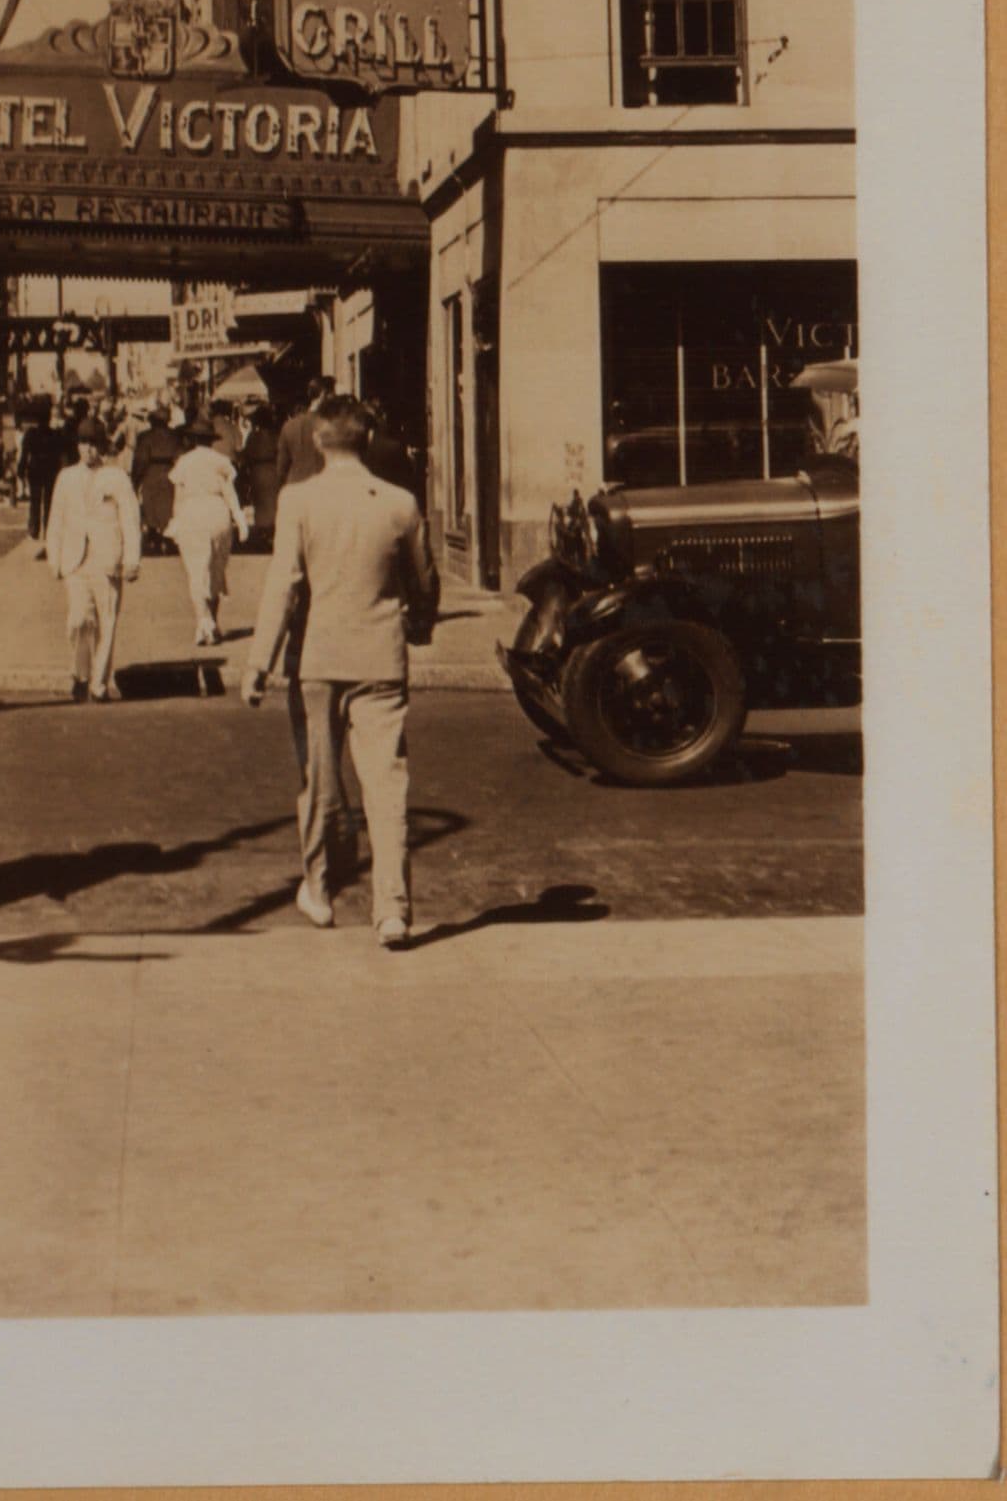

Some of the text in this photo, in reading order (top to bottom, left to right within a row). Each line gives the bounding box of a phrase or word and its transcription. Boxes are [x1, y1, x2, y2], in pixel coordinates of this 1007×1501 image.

[293, 2, 451, 65] GRILL
[102, 83, 379, 156] VICTORIA
[77, 197, 294, 229] RESTAURANTS
